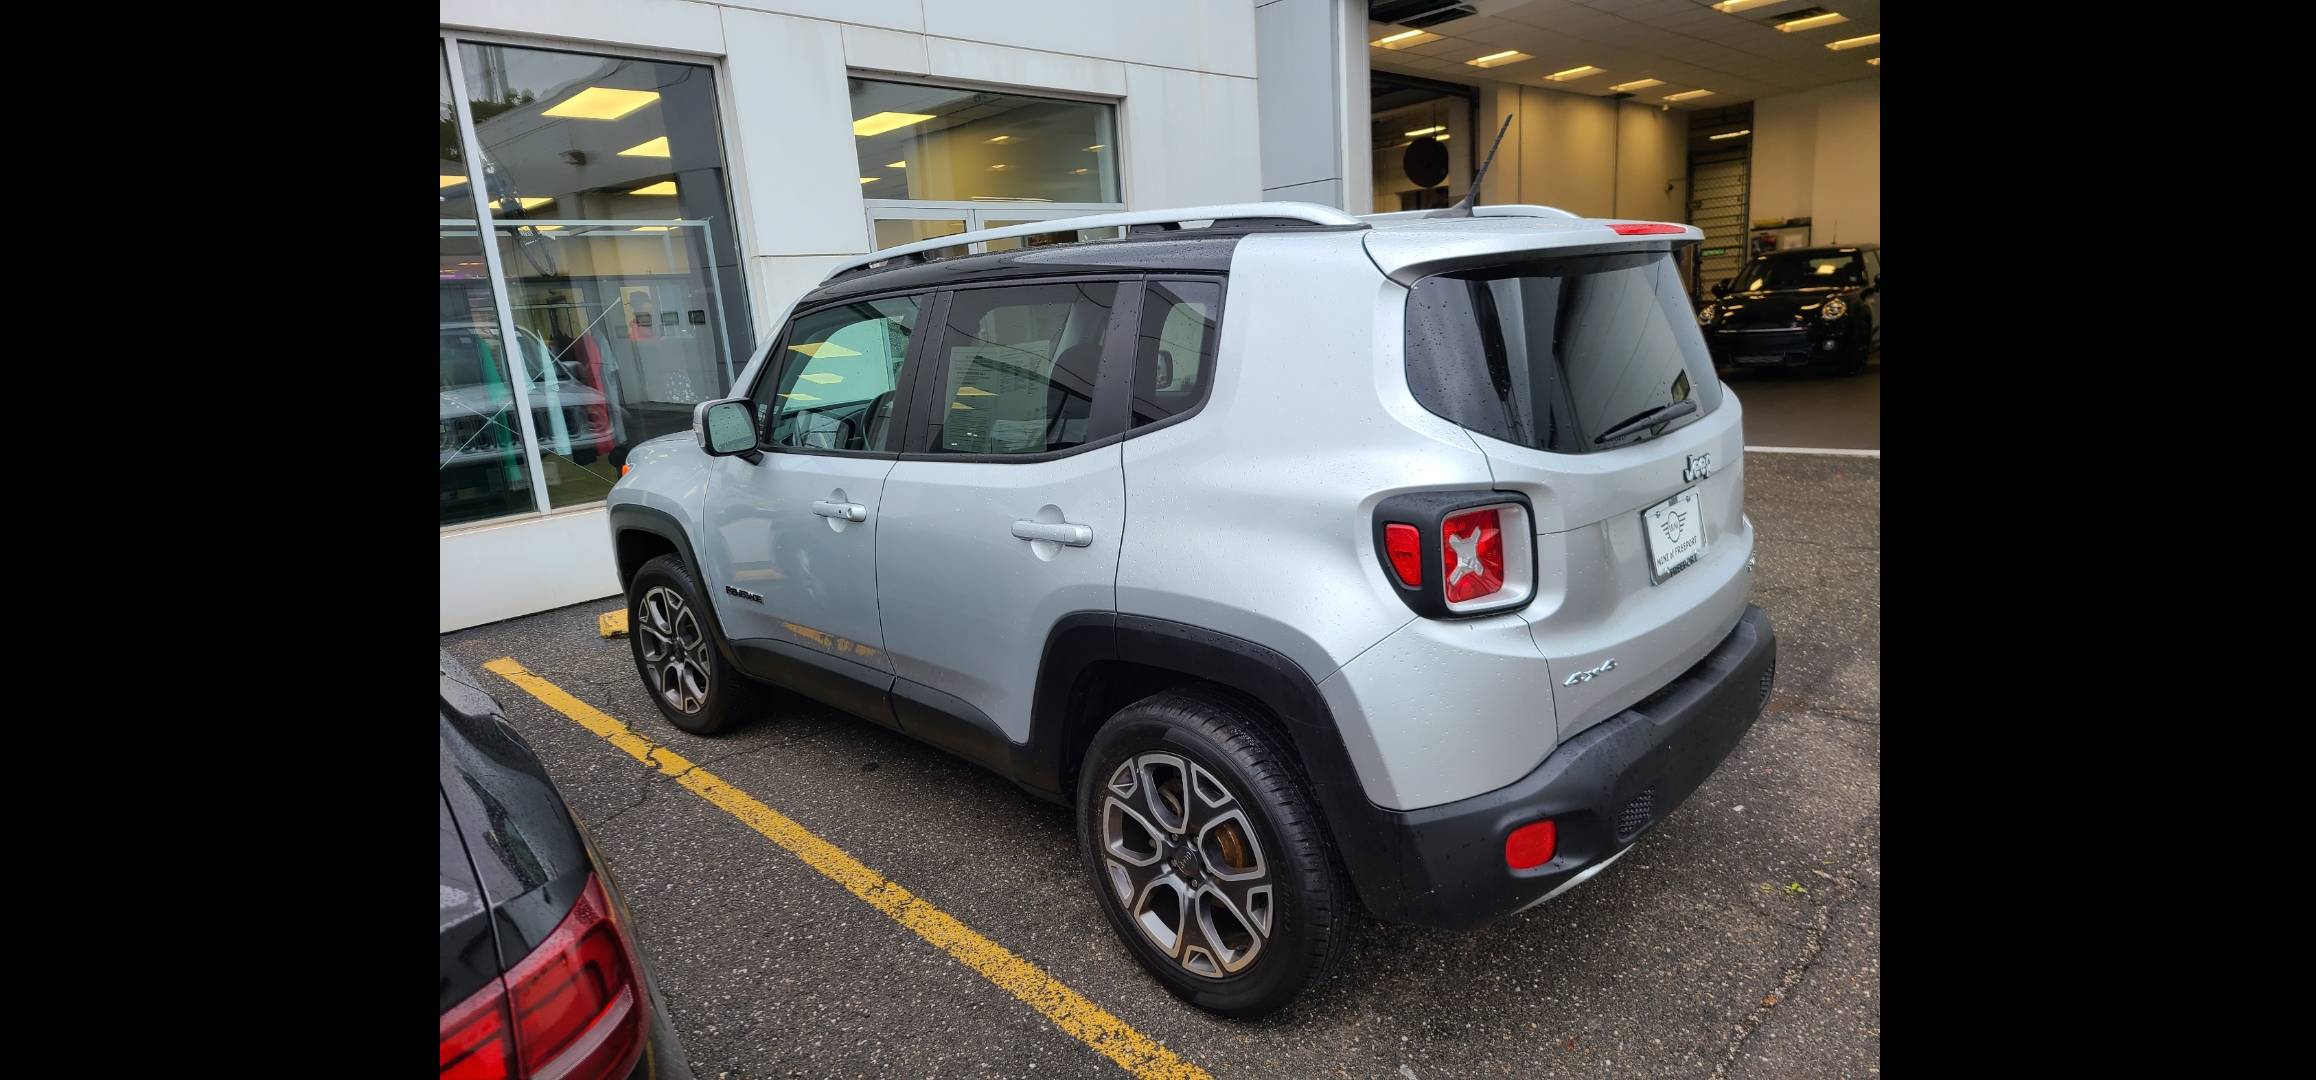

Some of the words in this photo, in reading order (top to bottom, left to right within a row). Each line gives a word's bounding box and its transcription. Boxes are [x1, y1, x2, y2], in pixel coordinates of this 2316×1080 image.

[1683, 453, 1711, 483] Jeep
[1674, 535, 1697, 556] FREEPORT
[1563, 657, 1618, 687] 4x4
